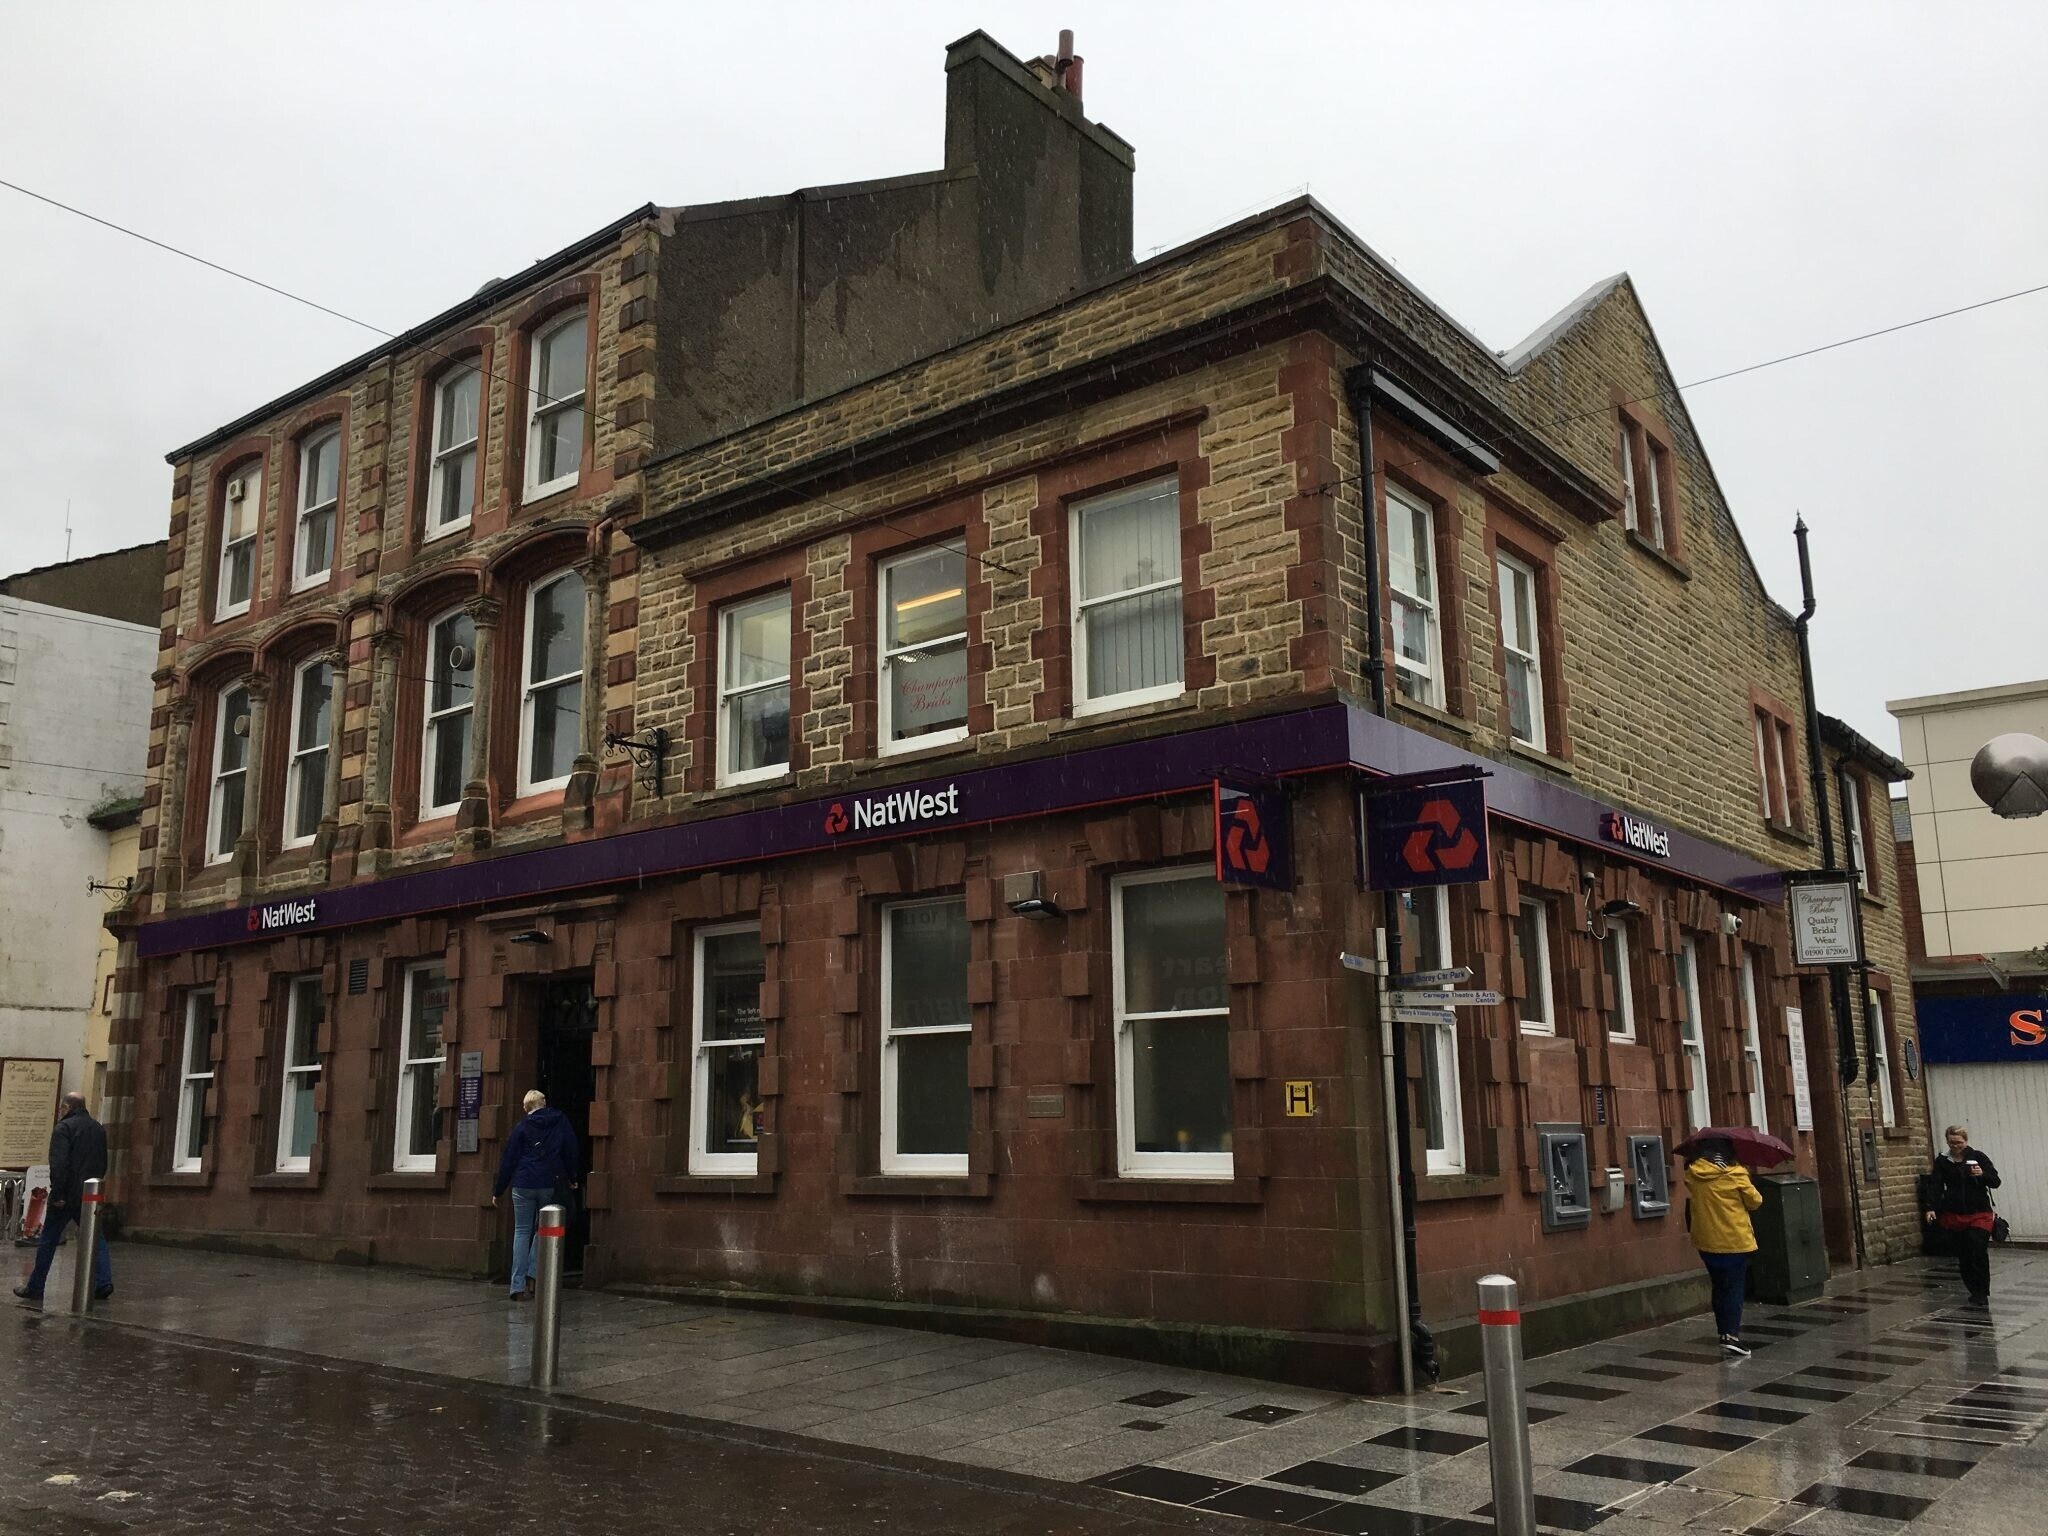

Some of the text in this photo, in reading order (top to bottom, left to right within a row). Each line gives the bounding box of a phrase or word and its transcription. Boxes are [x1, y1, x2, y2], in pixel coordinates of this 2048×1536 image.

[901, 674, 967, 695] Champagn
[854, 783, 959, 830] NatWest
[1624, 816, 1671, 858] NatWest
[262, 898, 316, 929] NatWest
[1807, 915, 1839, 926] Quality
[1812, 926, 1837, 935] Bridal
[1814, 936, 1837, 944] Wear
[1437, 972, 1448, 980] Car
[1450, 971, 1466, 980] Park
[2009, 1009, 2048, 1045] S
[1290, 1085, 1310, 1113] H
